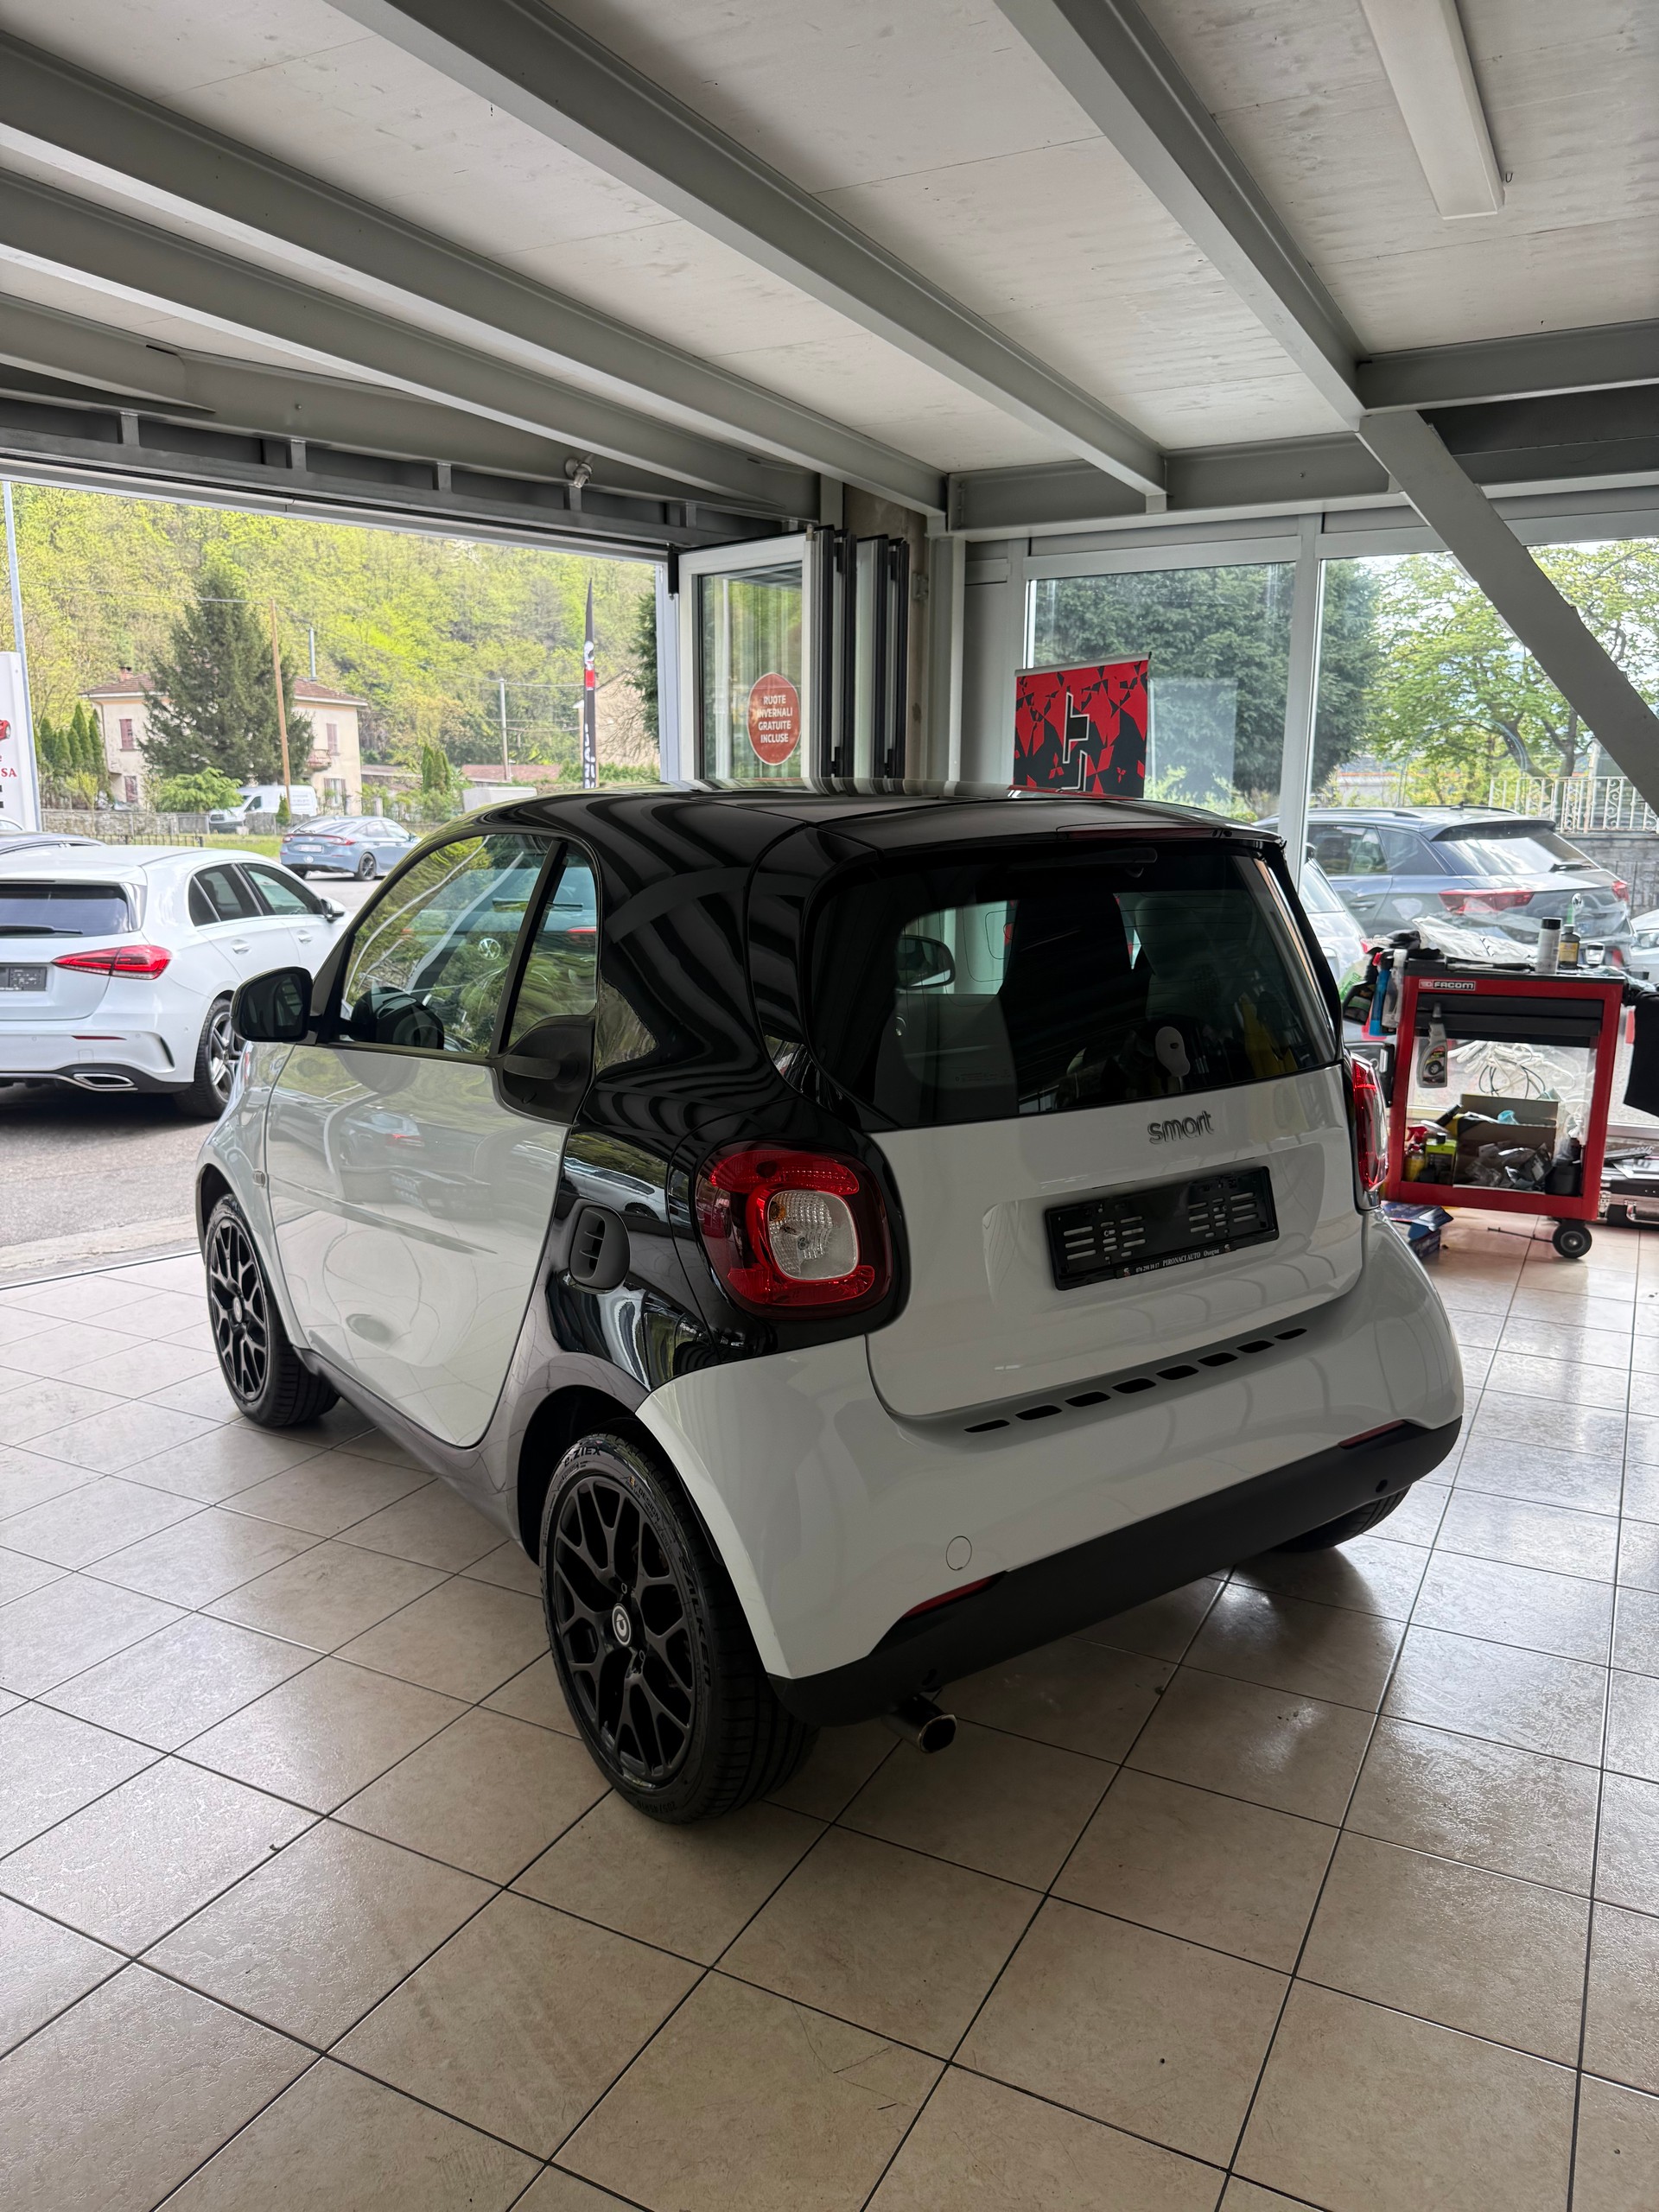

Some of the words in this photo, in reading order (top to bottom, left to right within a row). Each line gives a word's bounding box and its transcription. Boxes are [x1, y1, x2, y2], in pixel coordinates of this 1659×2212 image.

[763, 695, 786, 704] RUOTE
[757, 707, 793, 718] INVERNALI
[758, 720, 791, 731] GRATUITE
[760, 733, 789, 743] INCLUSE
[1433, 981, 1474, 990] FACOM
[1186, 1252, 1201, 1262] AUTO
[564, 1446, 601, 1467] e.ZIEX
[639, 1487, 661, 1522] DESIGN
[678, 1556, 712, 1688] FALKEN
